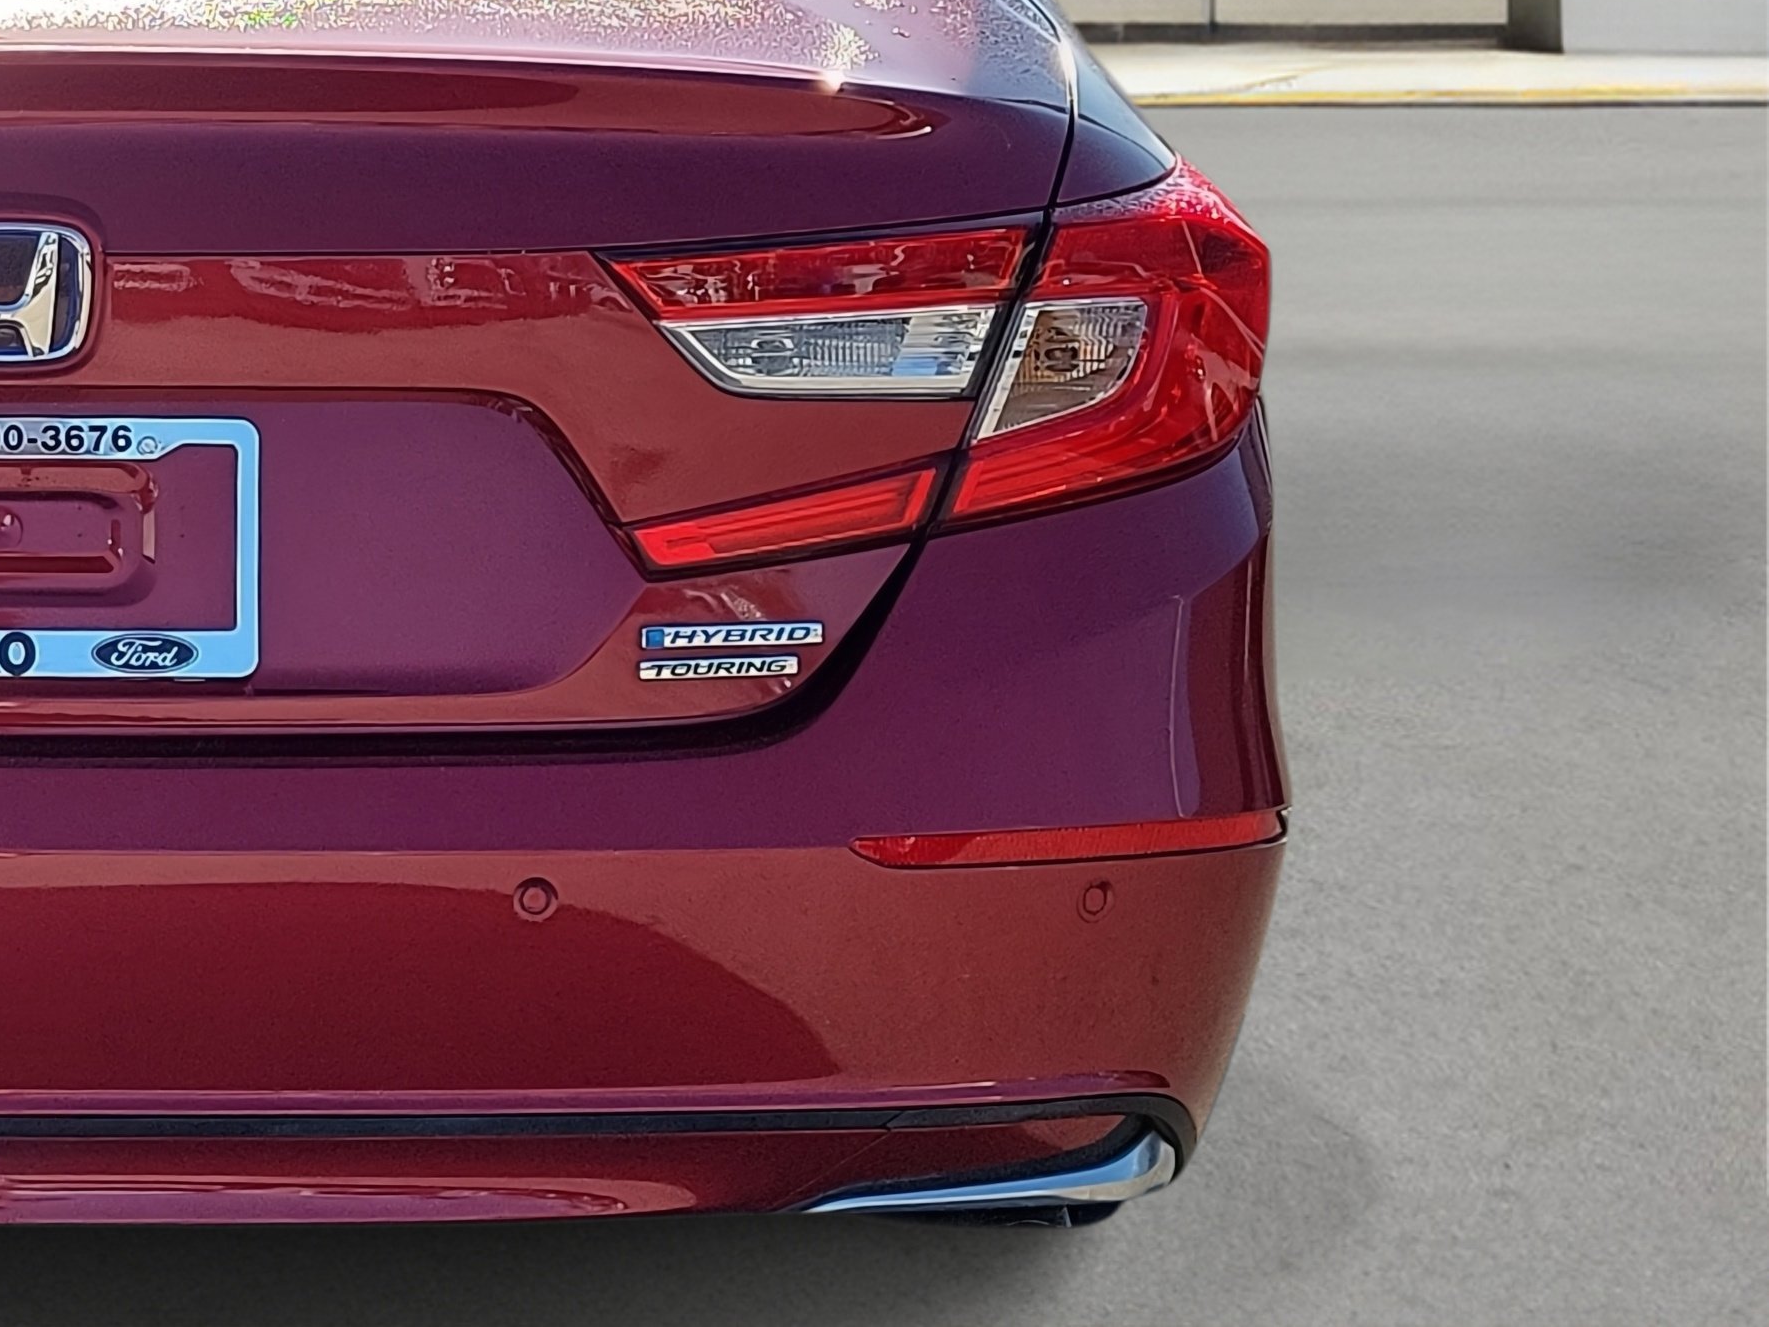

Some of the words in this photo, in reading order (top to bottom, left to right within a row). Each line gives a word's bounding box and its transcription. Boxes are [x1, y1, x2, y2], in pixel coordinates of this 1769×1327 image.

[669, 627, 811, 644] HYBRID
[110, 639, 178, 667] Ford
[647, 659, 790, 677] TOURING
